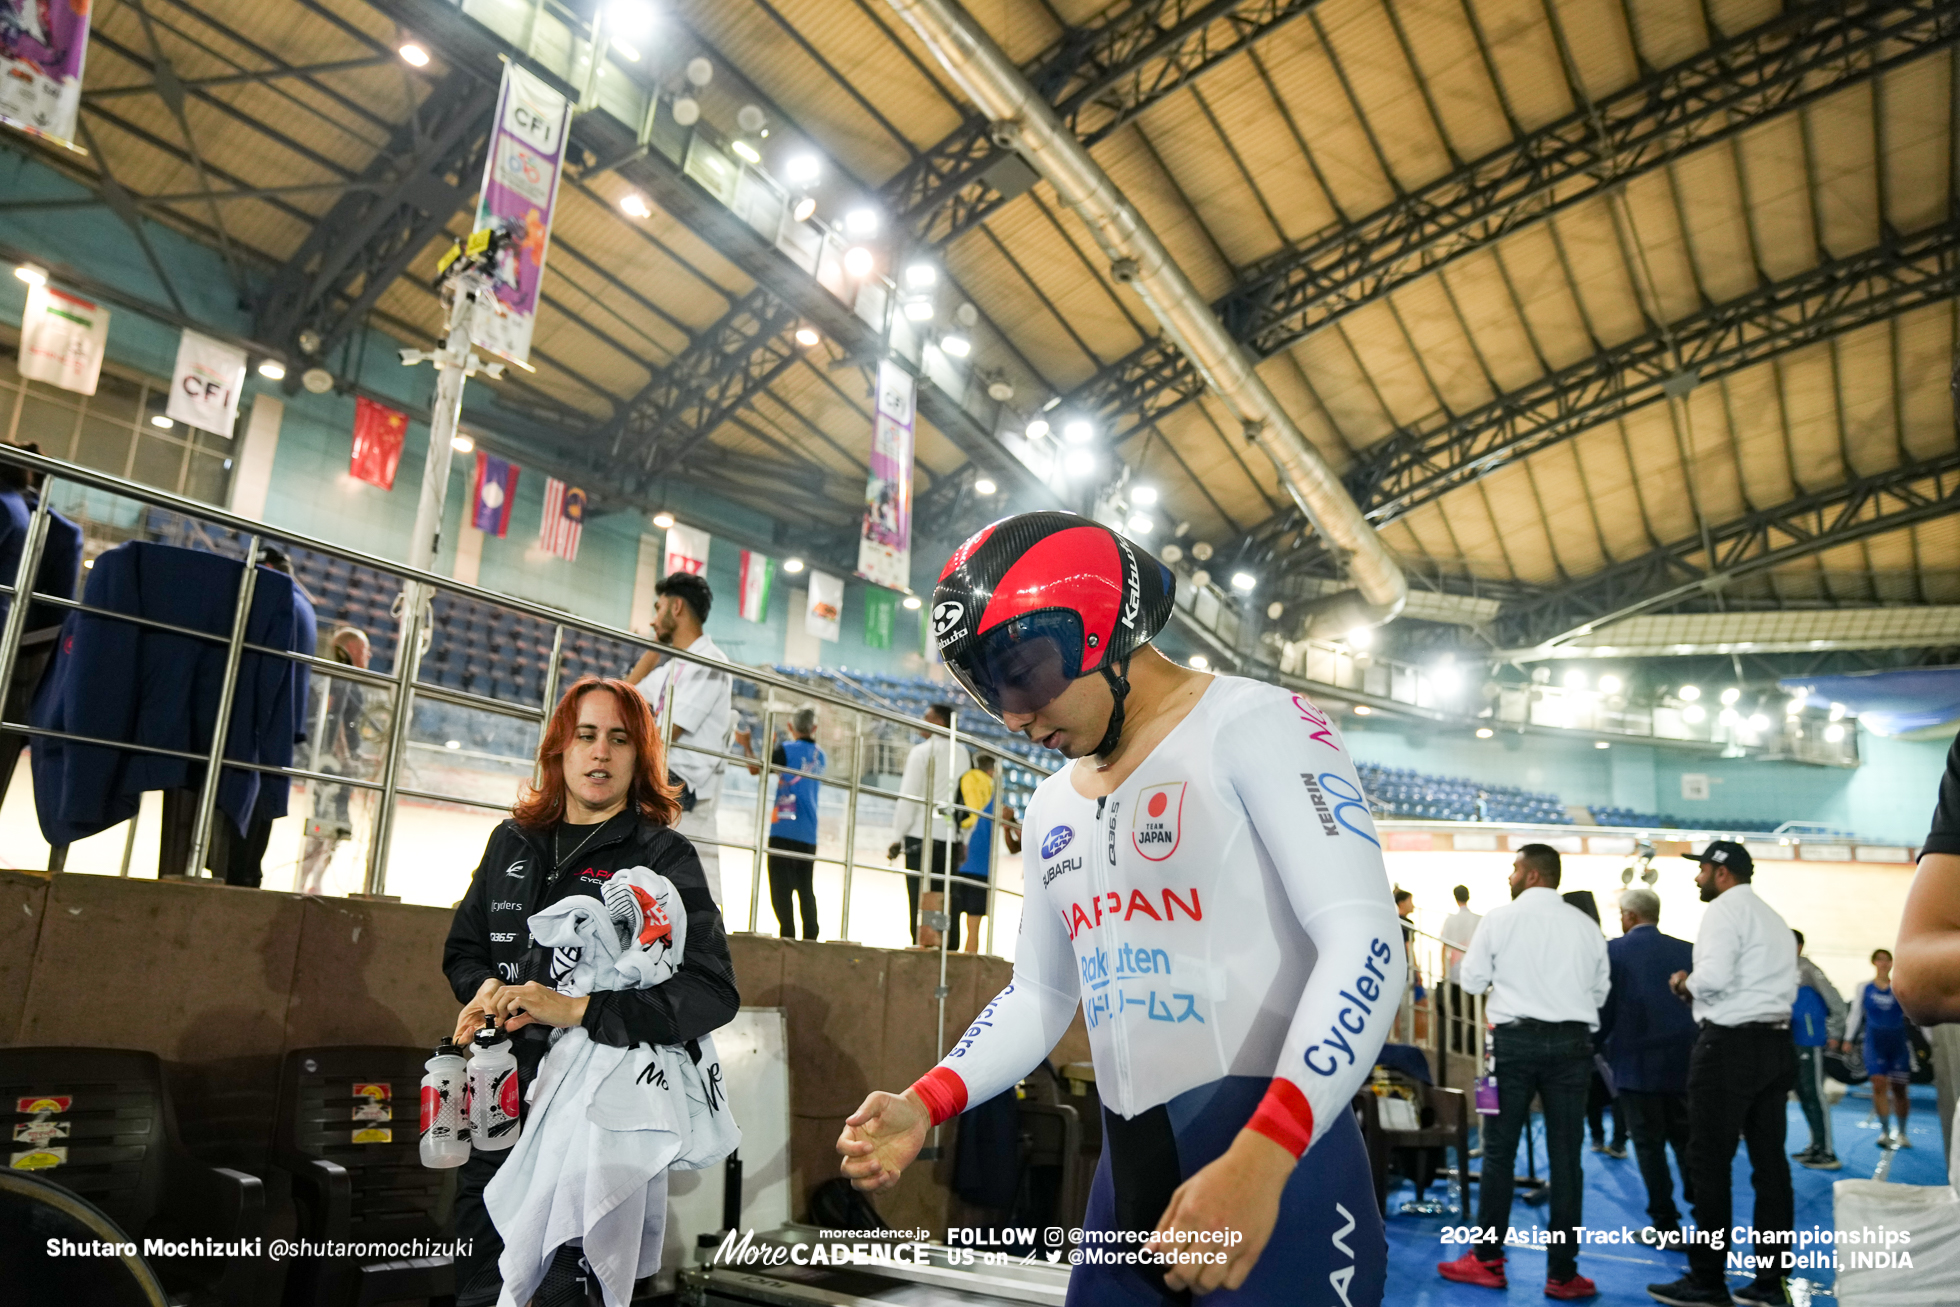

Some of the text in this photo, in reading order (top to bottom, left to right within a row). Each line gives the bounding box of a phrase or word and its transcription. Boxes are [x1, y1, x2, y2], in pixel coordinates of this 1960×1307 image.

[514, 107, 550, 142] CFI
[183, 376, 230, 407] CFI
[1300, 773, 1339, 836] KEIRIN
[1138, 831, 1172, 844] JAPAN
[1062, 888, 1202, 941] JAPAN
[1304, 938, 1391, 1076] Cyclers
